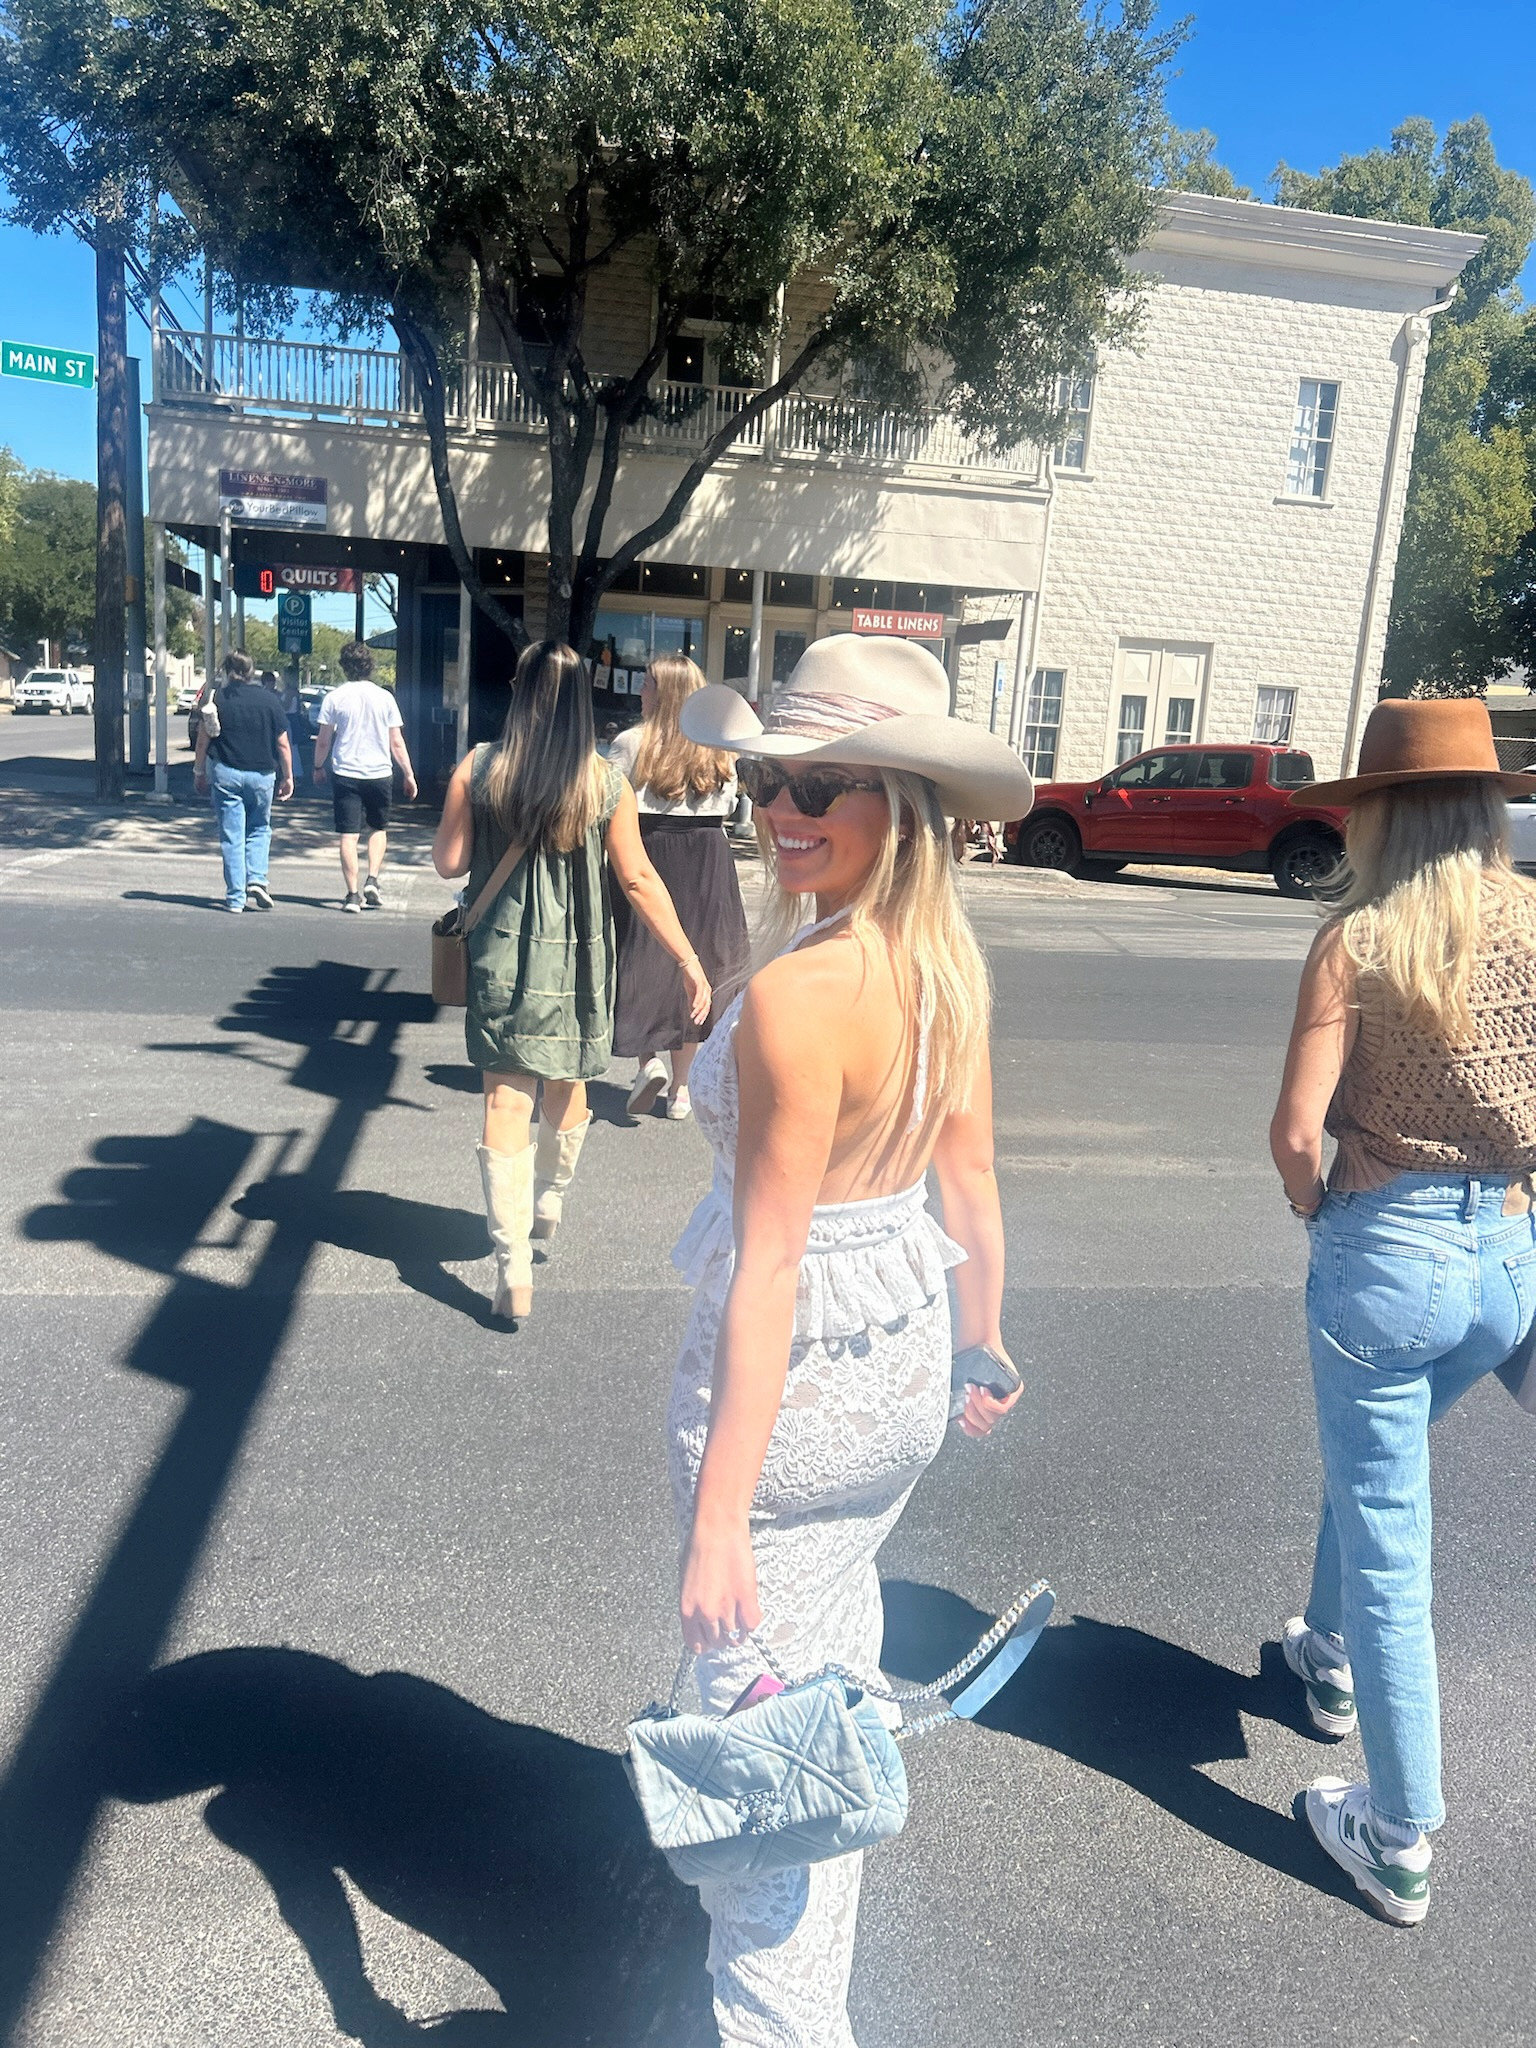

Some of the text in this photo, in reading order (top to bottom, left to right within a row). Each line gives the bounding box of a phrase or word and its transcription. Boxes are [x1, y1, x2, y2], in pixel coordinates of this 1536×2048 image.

[9, 350, 87, 379] MAIN ST
[281, 568, 338, 586] QUILTS
[282, 617, 309, 627] Visitor
[857, 614, 939, 632] TABLE LINENS
[281, 627, 309, 637] Center
